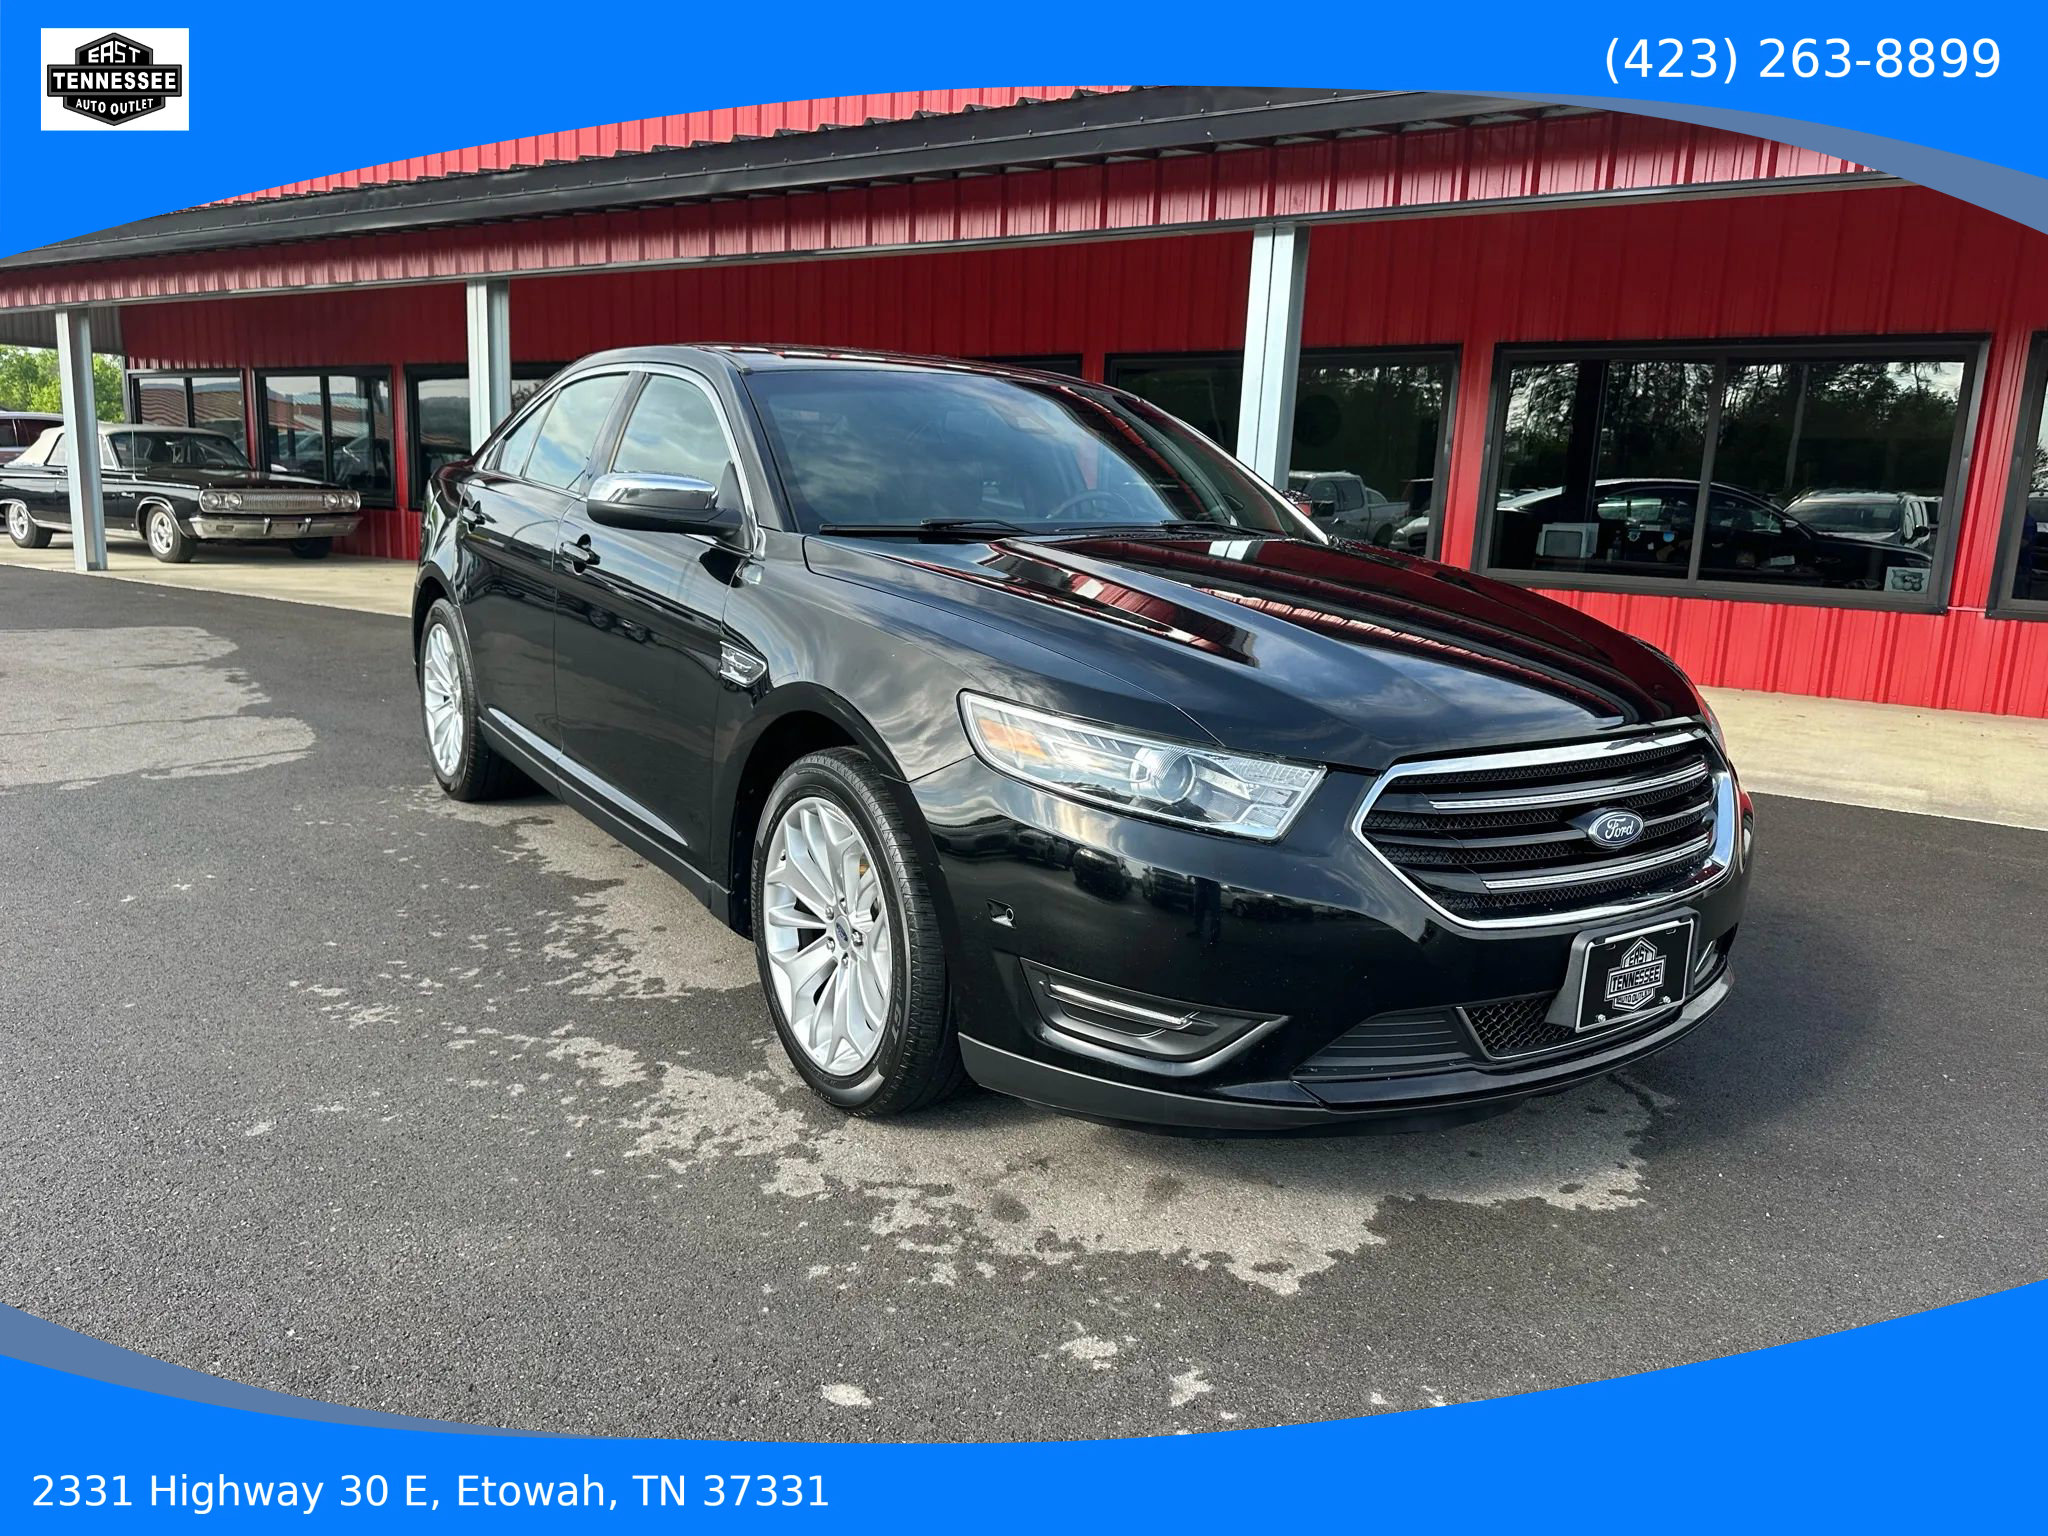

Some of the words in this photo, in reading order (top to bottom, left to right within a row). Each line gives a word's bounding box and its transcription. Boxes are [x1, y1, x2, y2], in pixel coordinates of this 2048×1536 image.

[1604, 817, 1635, 840] Ford
[1628, 947, 1650, 966] EAST
[1612, 965, 1661, 992] TENNESSEE
